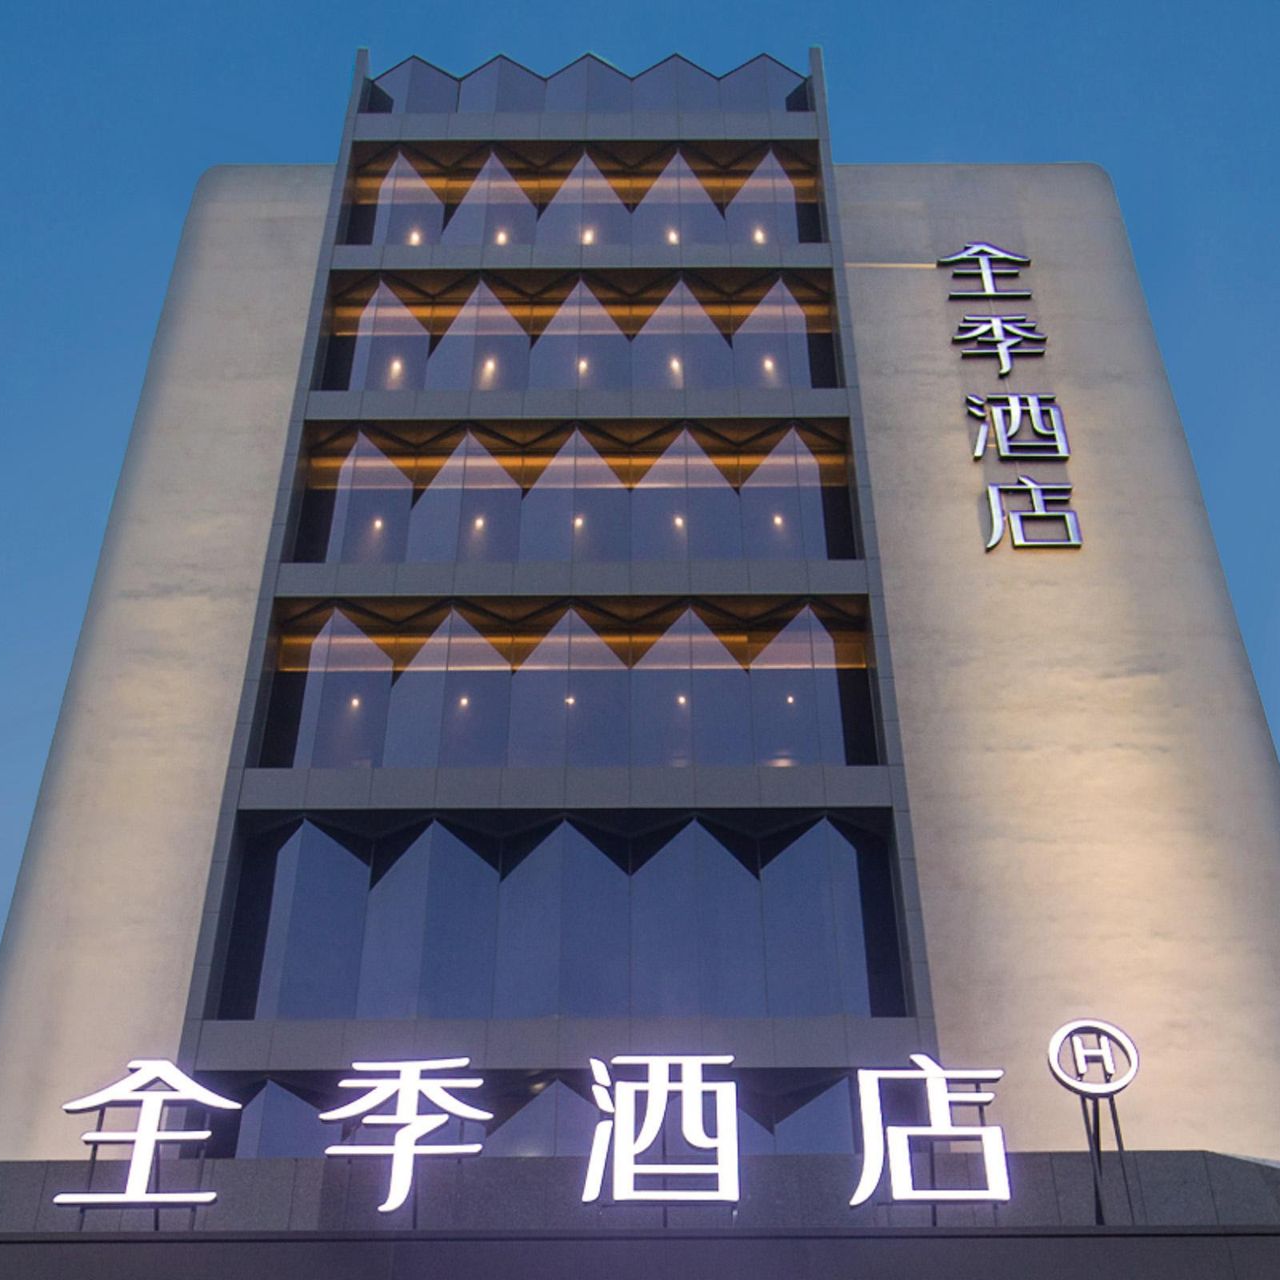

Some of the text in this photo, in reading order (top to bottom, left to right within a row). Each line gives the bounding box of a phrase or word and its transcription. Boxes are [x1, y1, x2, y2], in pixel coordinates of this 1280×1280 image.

[936, 241, 1082, 552] 全季酒店
[53, 1053, 1011, 1212] 全季酒店
